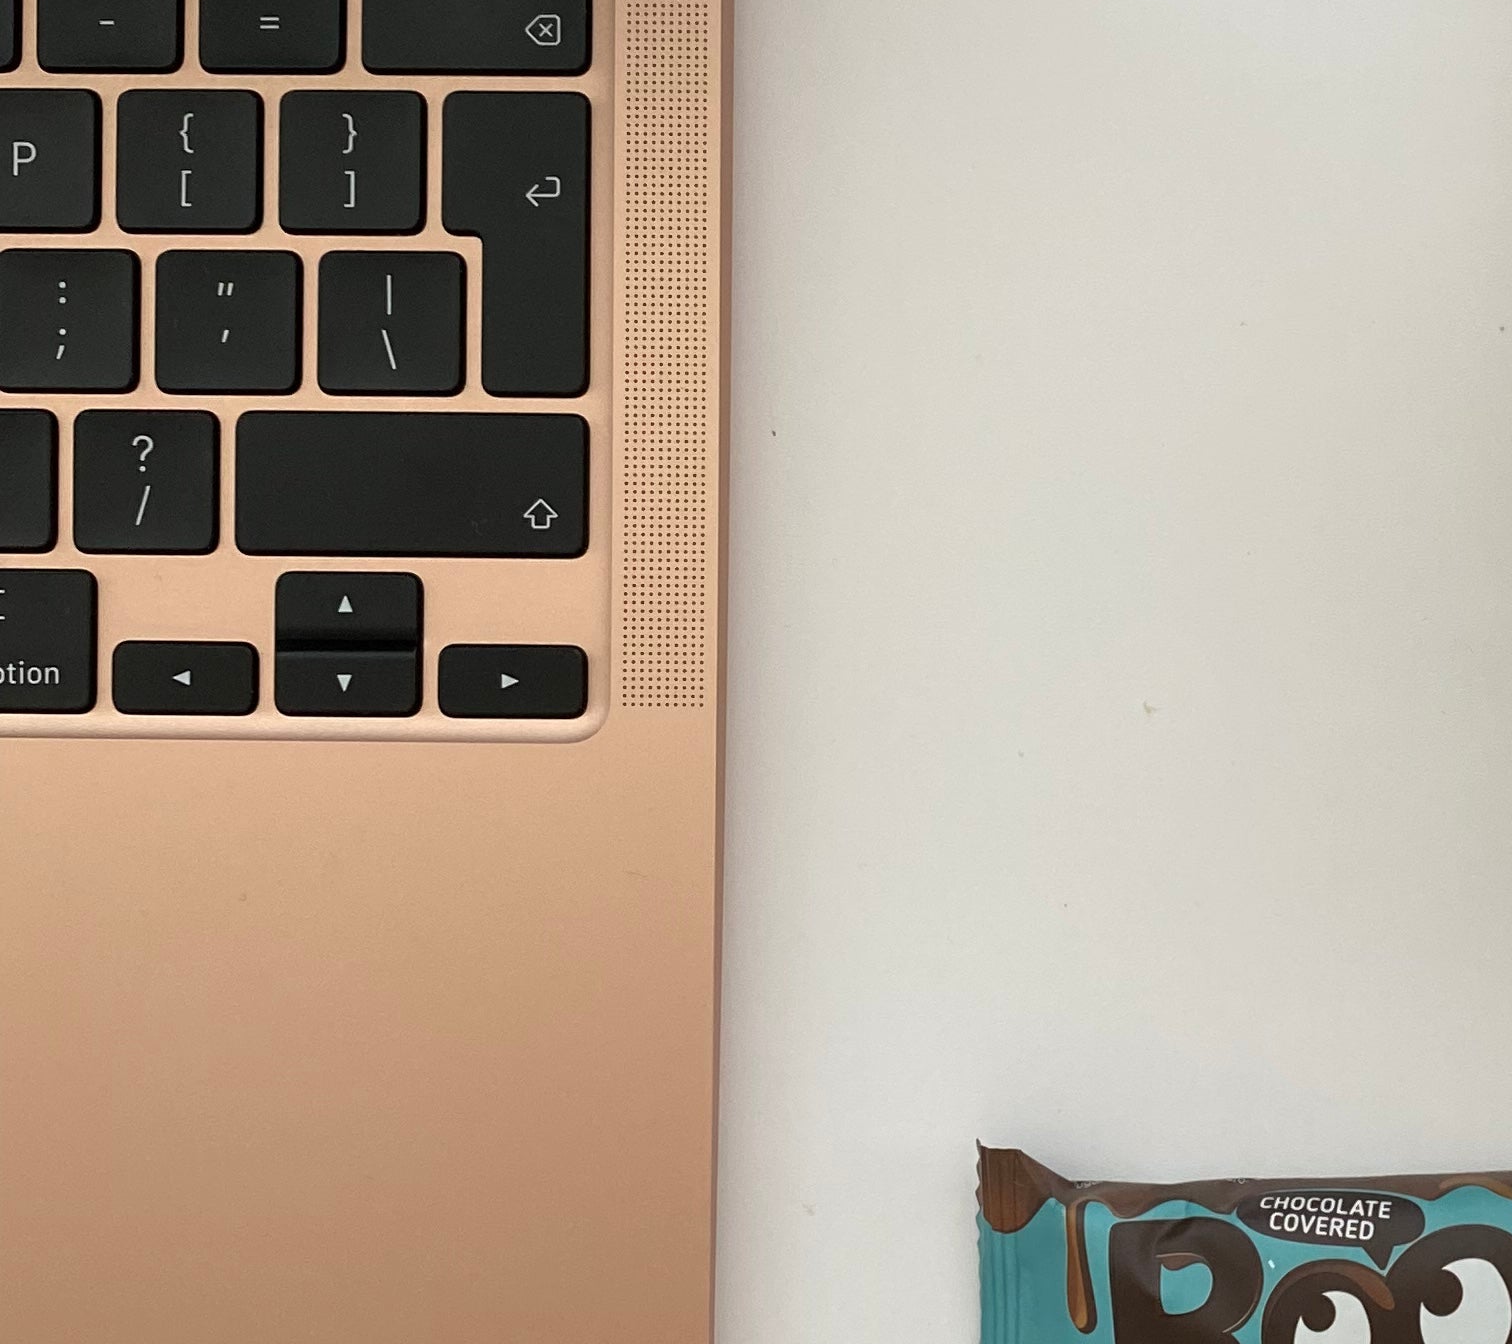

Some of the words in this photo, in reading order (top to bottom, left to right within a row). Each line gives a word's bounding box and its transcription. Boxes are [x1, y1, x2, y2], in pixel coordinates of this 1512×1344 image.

[12, 141, 37, 176] P
[1259, 1196, 1392, 1219] CHOCOLATE
[1269, 1212, 1375, 1240] COVERED
